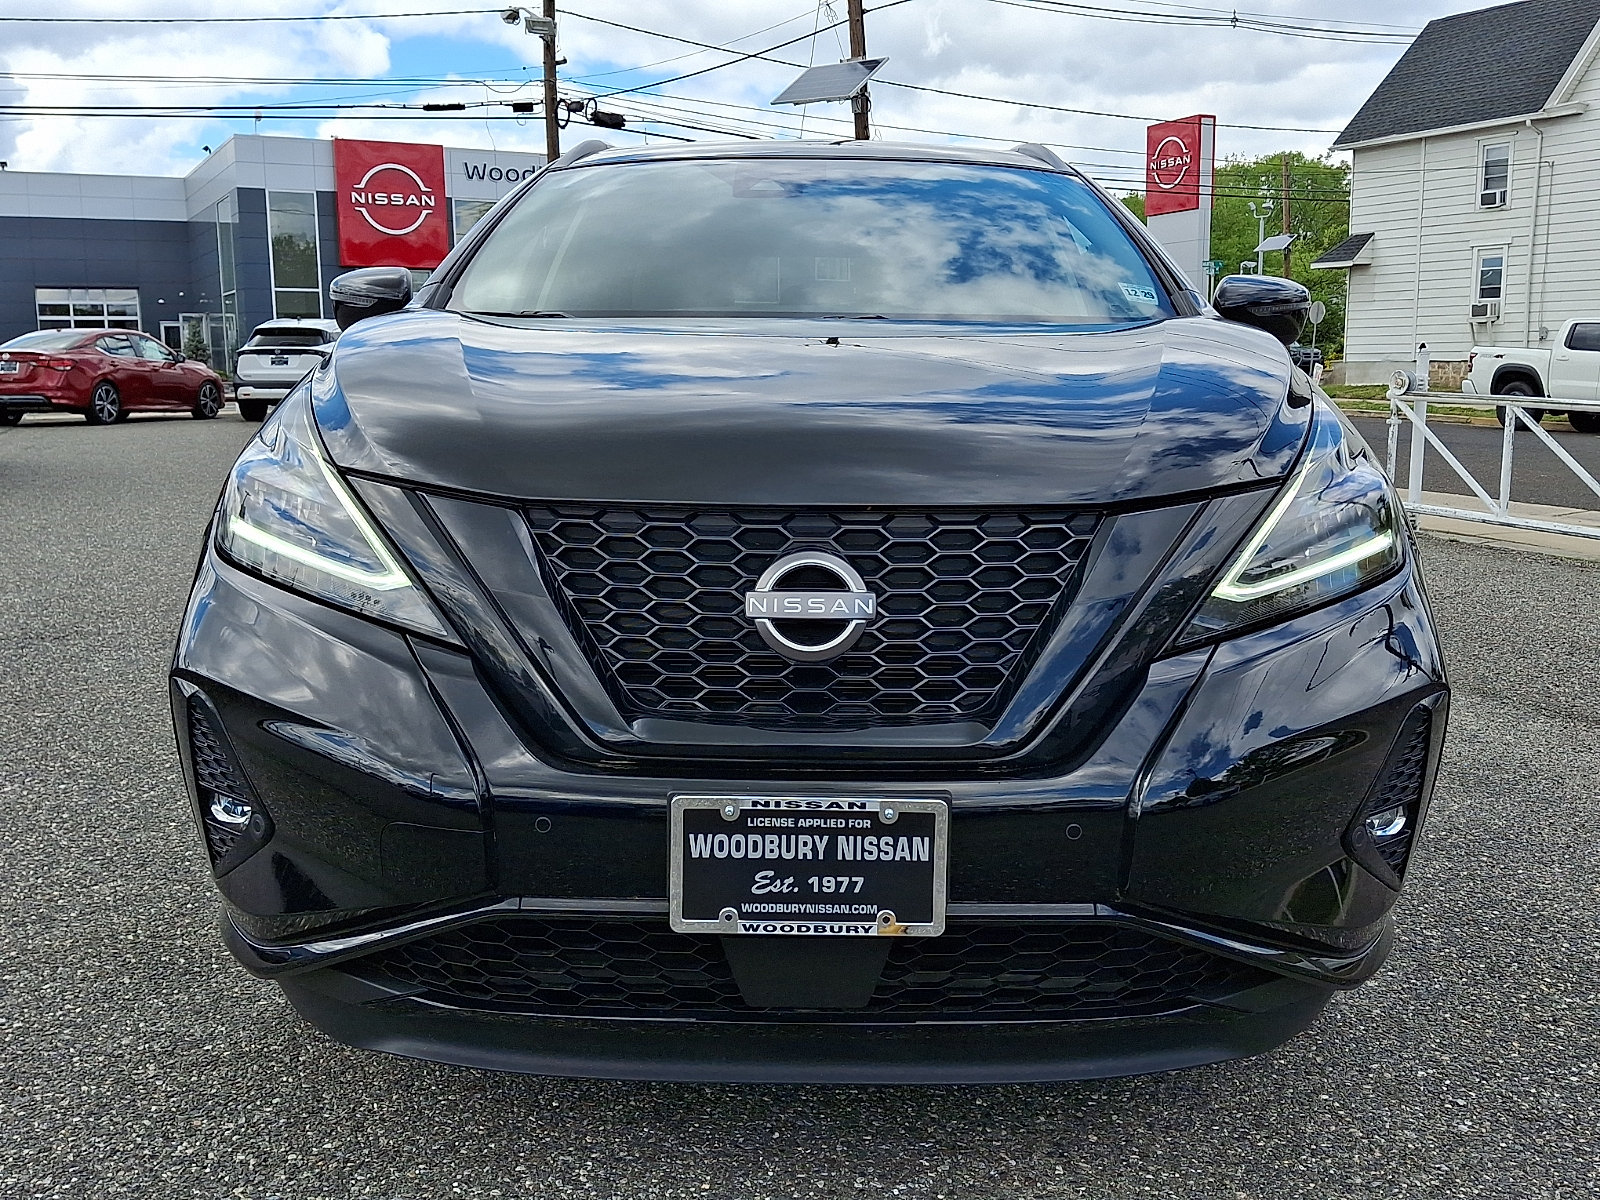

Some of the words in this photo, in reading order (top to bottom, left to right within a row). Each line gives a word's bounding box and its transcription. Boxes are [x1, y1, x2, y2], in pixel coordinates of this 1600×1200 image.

[1150, 154, 1191, 170] NISSAN
[464, 162, 542, 182] Wood
[351, 191, 435, 207] NISSAN
[749, 597, 873, 614] NISSAN
[751, 800, 867, 811] NISSAN
[747, 817, 795, 828] LICENSE
[798, 818, 846, 829] APPLIED
[848, 819, 872, 829] FOR
[689, 833, 829, 860] WOODBURY
[837, 835, 930, 862] NISSAN
[751, 870, 799, 895] Est.
[808, 876, 865, 893] 1977
[741, 902, 878, 915] WOODBURYNISSAN.COM
[742, 923, 874, 934] WOODBURY
